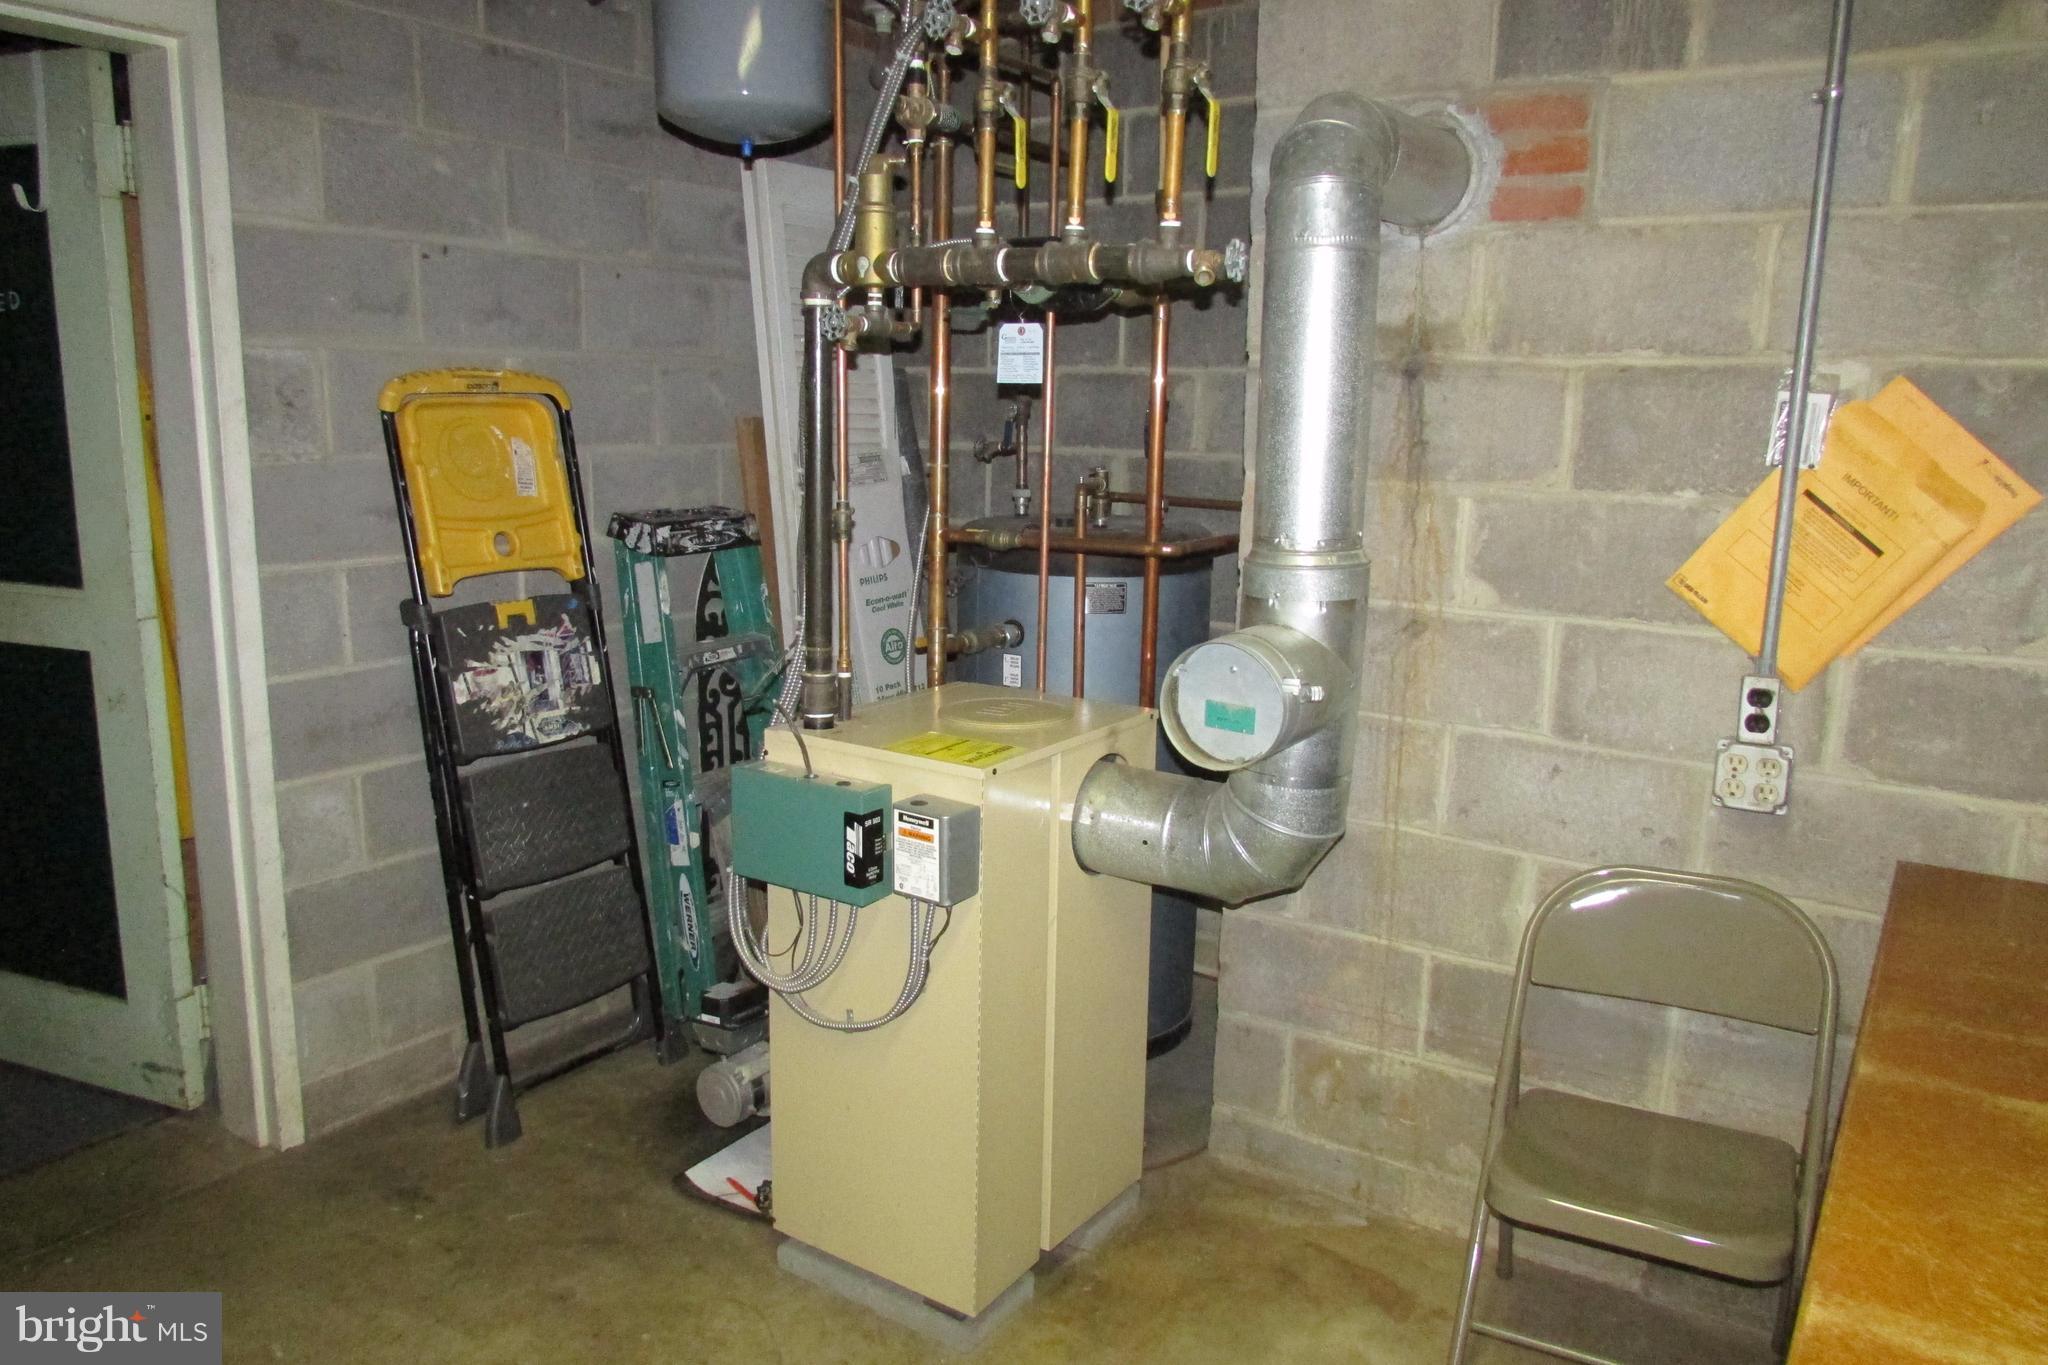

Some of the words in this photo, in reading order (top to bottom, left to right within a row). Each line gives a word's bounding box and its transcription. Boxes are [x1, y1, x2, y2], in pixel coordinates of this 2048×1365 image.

[1842, 472, 1900, 522] IMPORTANT!
[860, 573, 888, 586] PHILIPS
[885, 681, 902, 692] Pack
[903, 815, 929, 826] Honeywell
[683, 893, 697, 951] WERNER
